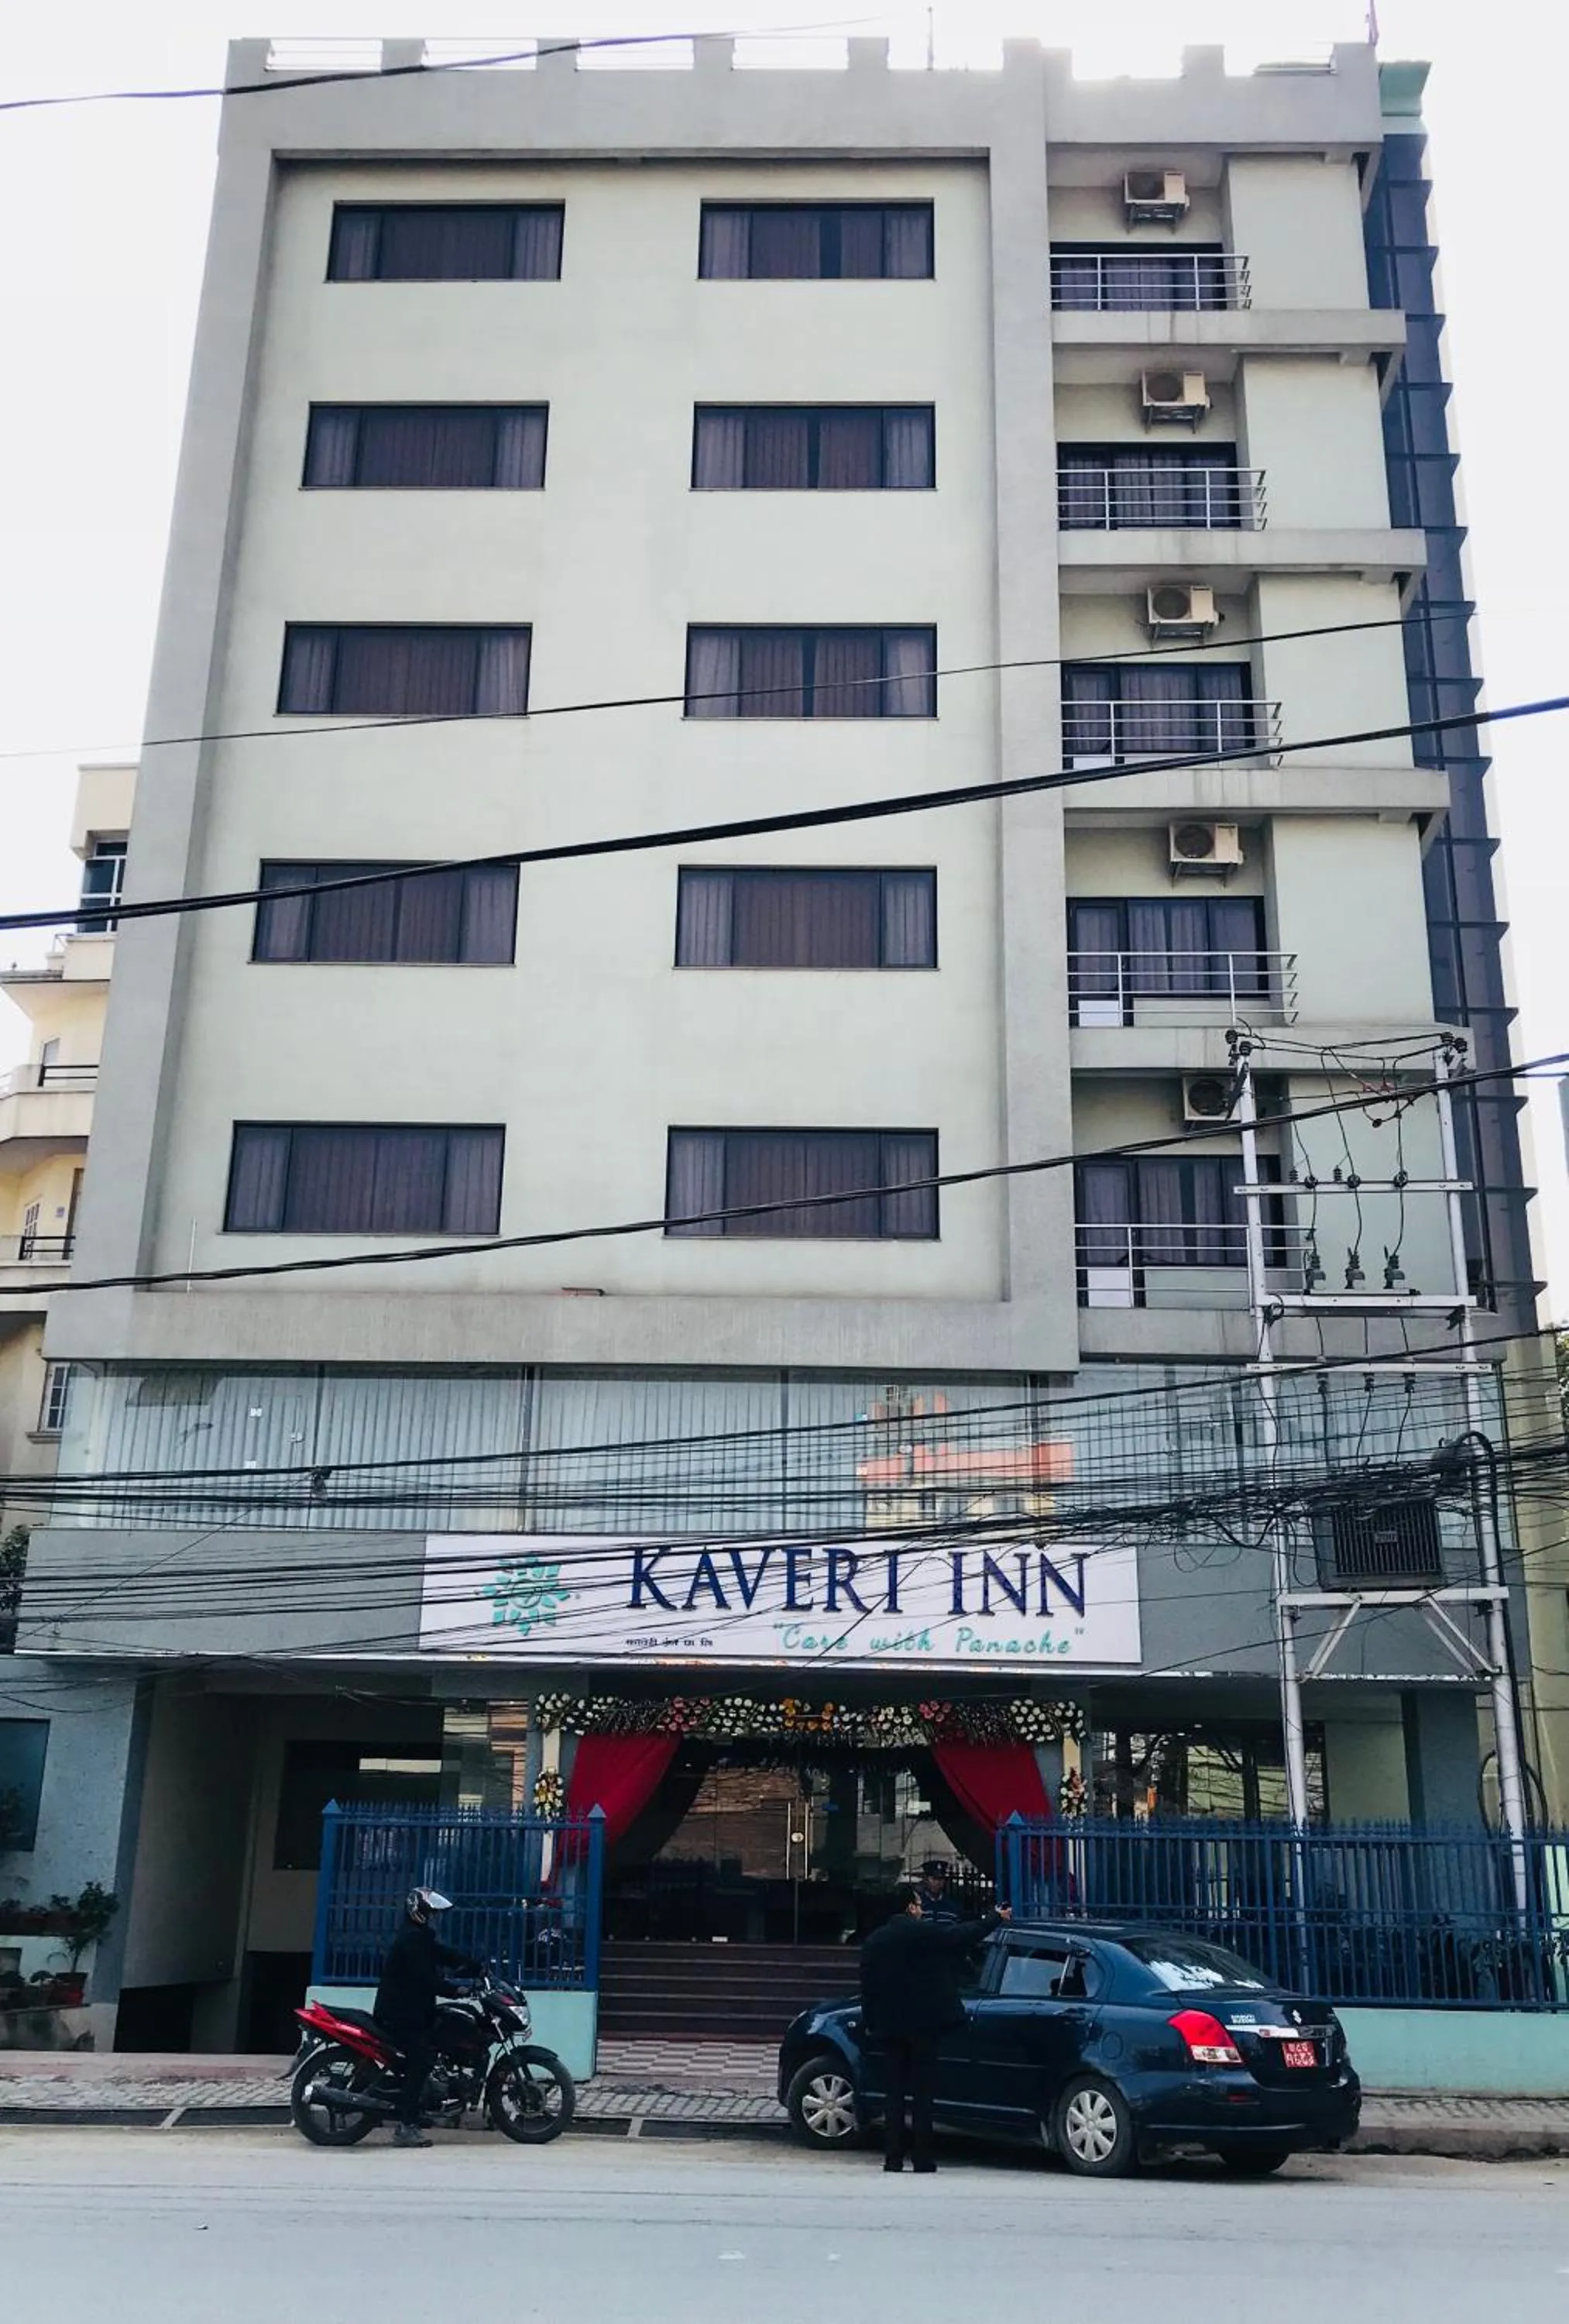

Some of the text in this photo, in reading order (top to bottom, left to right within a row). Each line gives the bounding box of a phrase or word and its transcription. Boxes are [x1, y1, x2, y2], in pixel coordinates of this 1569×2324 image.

[626, 1546, 1089, 1618] KAVERI INN
[870, 1626, 936, 1652] with
